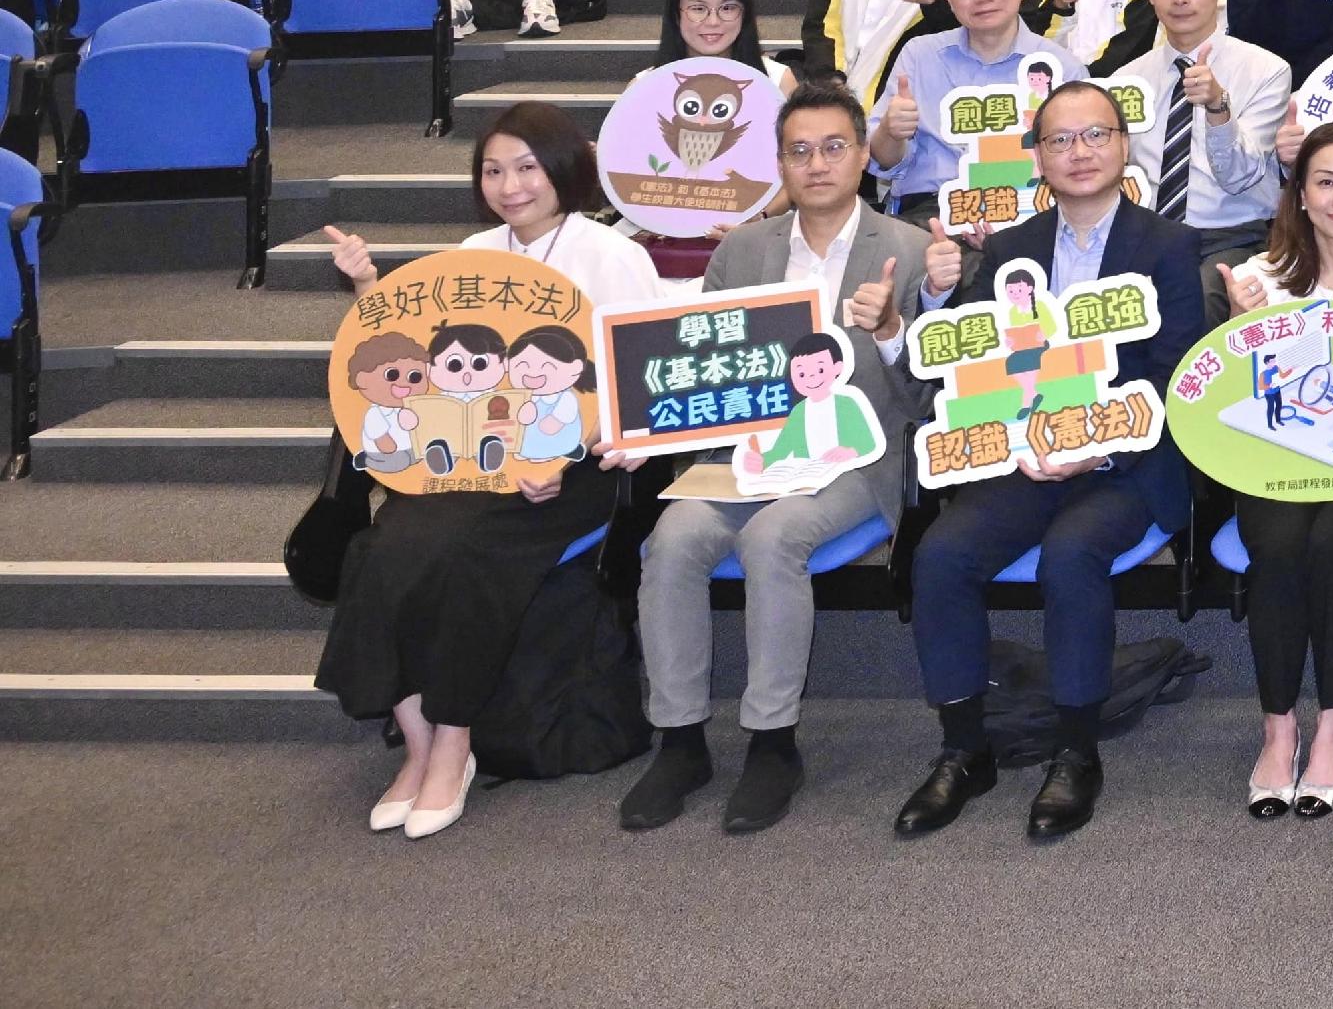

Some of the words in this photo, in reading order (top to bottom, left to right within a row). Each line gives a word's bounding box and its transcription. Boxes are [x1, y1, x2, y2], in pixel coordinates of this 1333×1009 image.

[951, 94, 1018, 133] 愈學
[949, 185, 1019, 225] 認識
[357, 274, 582, 330] 學好《基本法》
[919, 313, 999, 366] 愈學
[1065, 285, 1147, 339] 愈強
[679, 309, 746, 347] 學習
[644, 344, 788, 393] 《基本法》
[1176, 351, 1221, 400] 學好
[1228, 312, 1305, 355] 《憲法》
[649, 382, 789, 428] 公民責任
[927, 421, 1011, 476] 認識
[1026, 392, 1153, 455] 《憲法》
